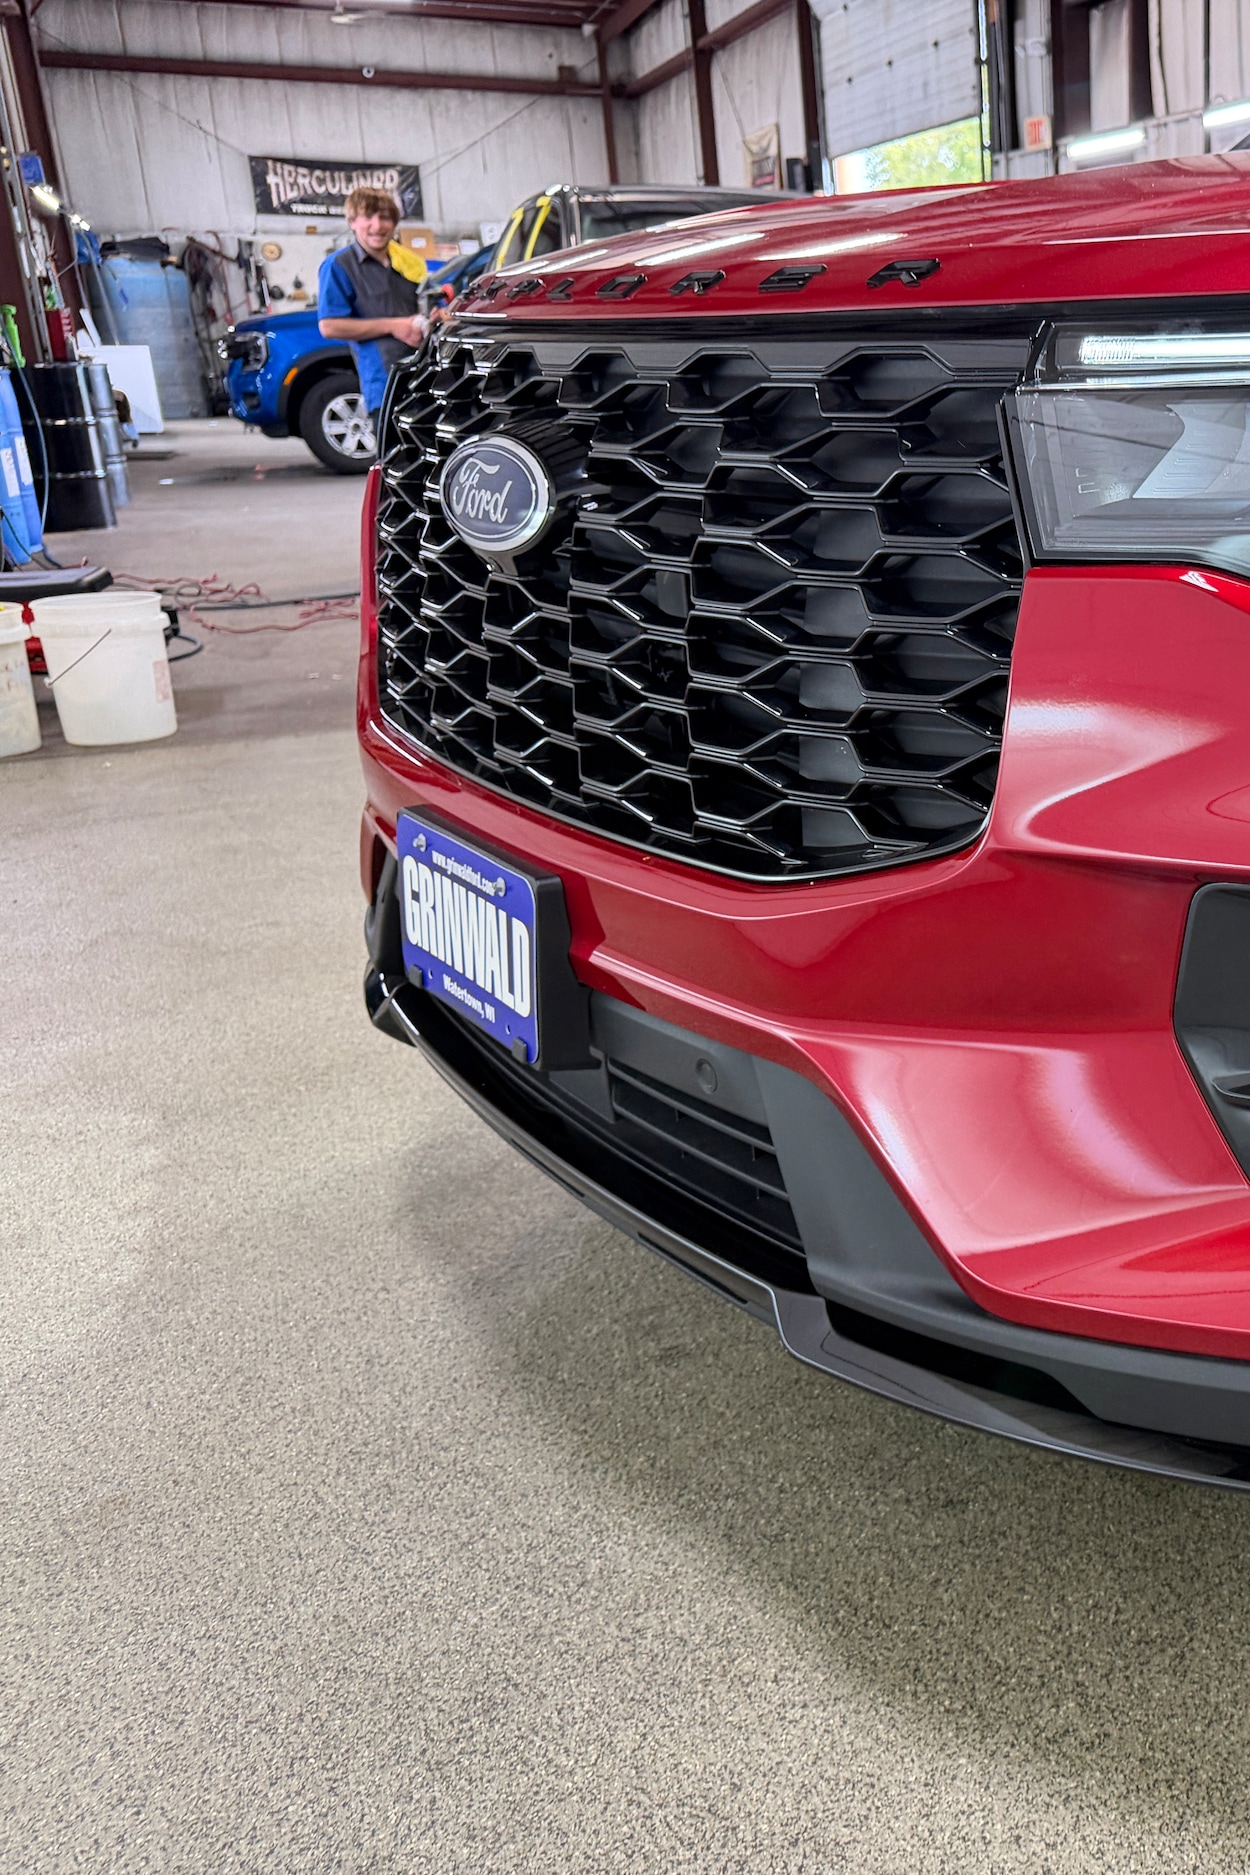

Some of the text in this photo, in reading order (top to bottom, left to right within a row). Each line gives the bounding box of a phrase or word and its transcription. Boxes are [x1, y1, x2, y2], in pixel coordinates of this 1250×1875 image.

[266, 159, 405, 214] HERCULINER
[461, 257, 942, 301] EXPLORER
[453, 457, 513, 524] Ford
[402, 854, 532, 1019] GRINWALD
[443, 973, 496, 1024] Watertown, WI
